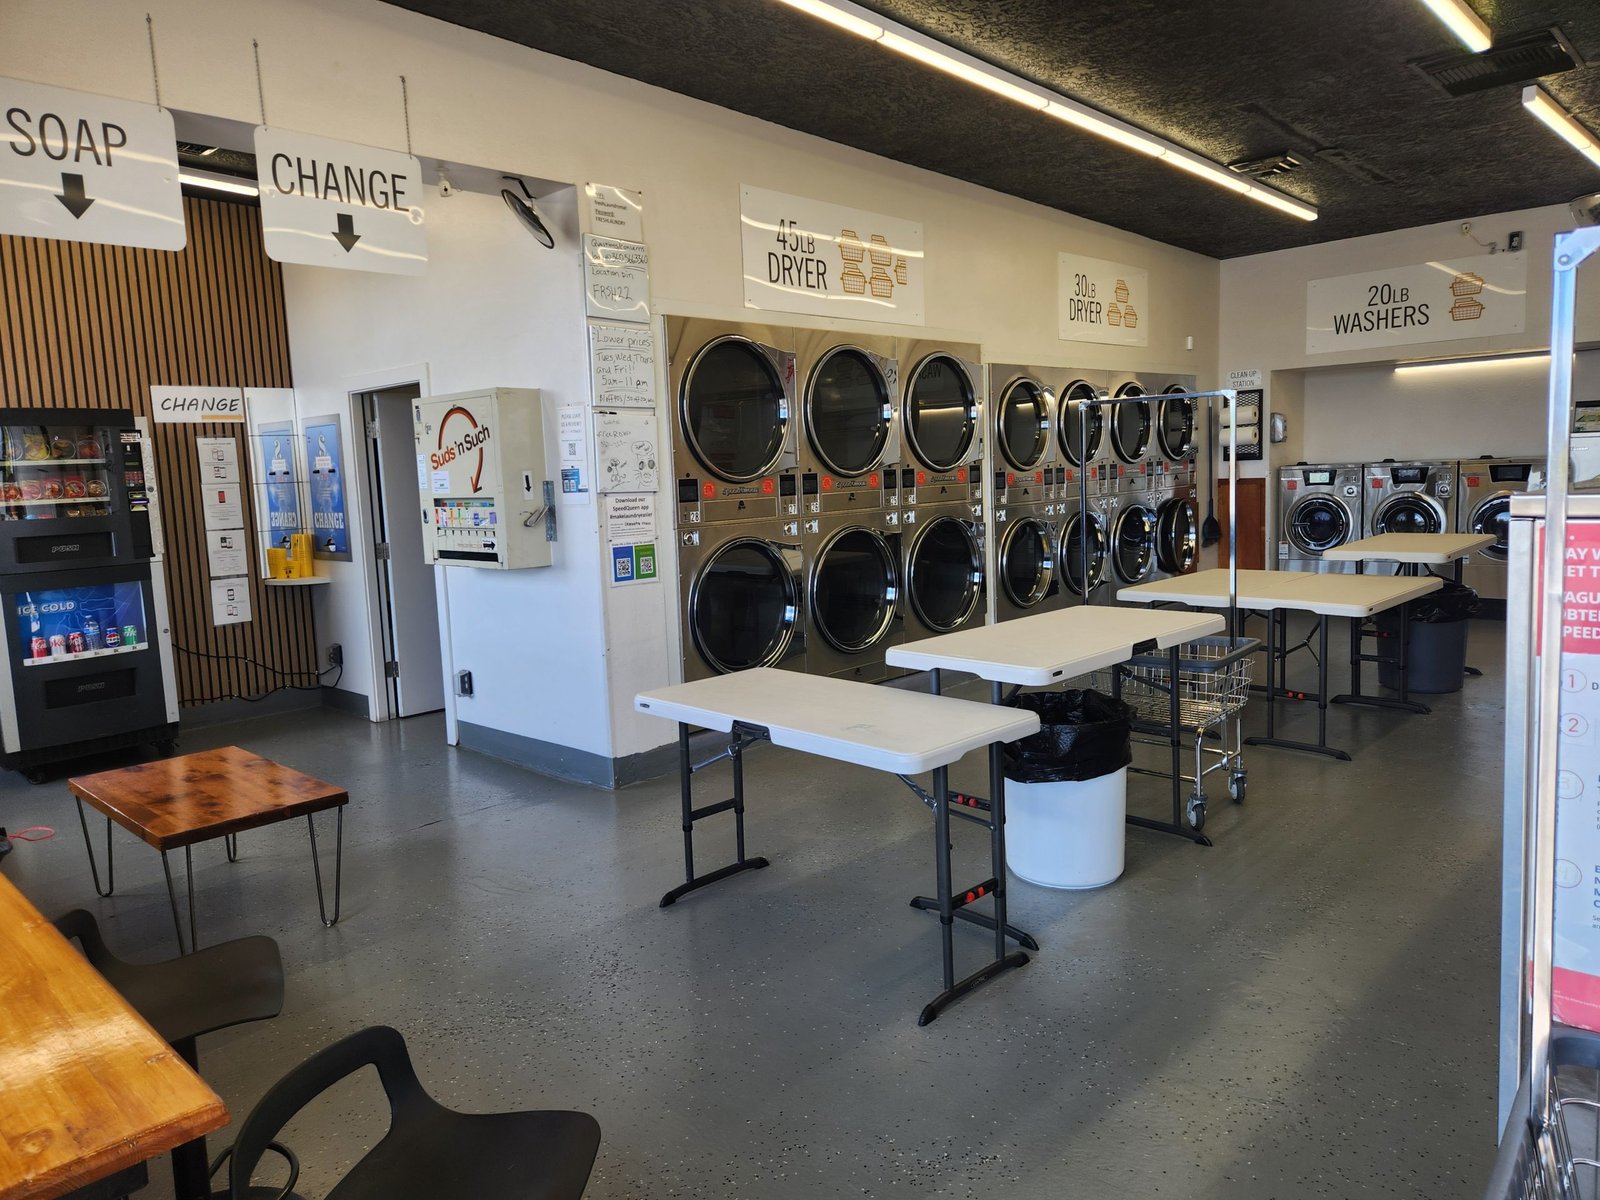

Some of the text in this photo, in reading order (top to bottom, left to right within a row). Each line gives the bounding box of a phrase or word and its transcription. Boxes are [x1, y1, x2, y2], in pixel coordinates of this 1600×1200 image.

[6, 107, 127, 167] SOAP
[271, 153, 410, 212] CHANGE
[776, 218, 816, 254] 45LB
[768, 251, 828, 290] DRYER
[1074, 273, 1097, 299] 30LB
[1367, 283, 1410, 307] 20LB
[1069, 298, 1102, 325] DRYER
[1333, 303, 1430, 335] WASHERS
[596, 330, 625, 344] Lower
[596, 366, 611, 374] and
[1230, 369, 1257, 379] CLEAN UP
[1232, 380, 1255, 388] STATION
[161, 396, 240, 412] CHANGE
[430, 445, 456, 471] Suds
[463, 423, 491, 452] Such
[314, 511, 345, 529] CHANGE
[690, 511, 700, 523] 28
[1564, 548, 1588, 560] AY
[1564, 565, 1587, 578] ET
[1564, 590, 1600, 605] AGU
[41, 601, 76, 613] COLD
[1564, 608, 1600, 622] BTE
[1563, 625, 1600, 640] PEED
[1569, 674, 1575, 689] 1
[1568, 717, 1579, 733] 2
